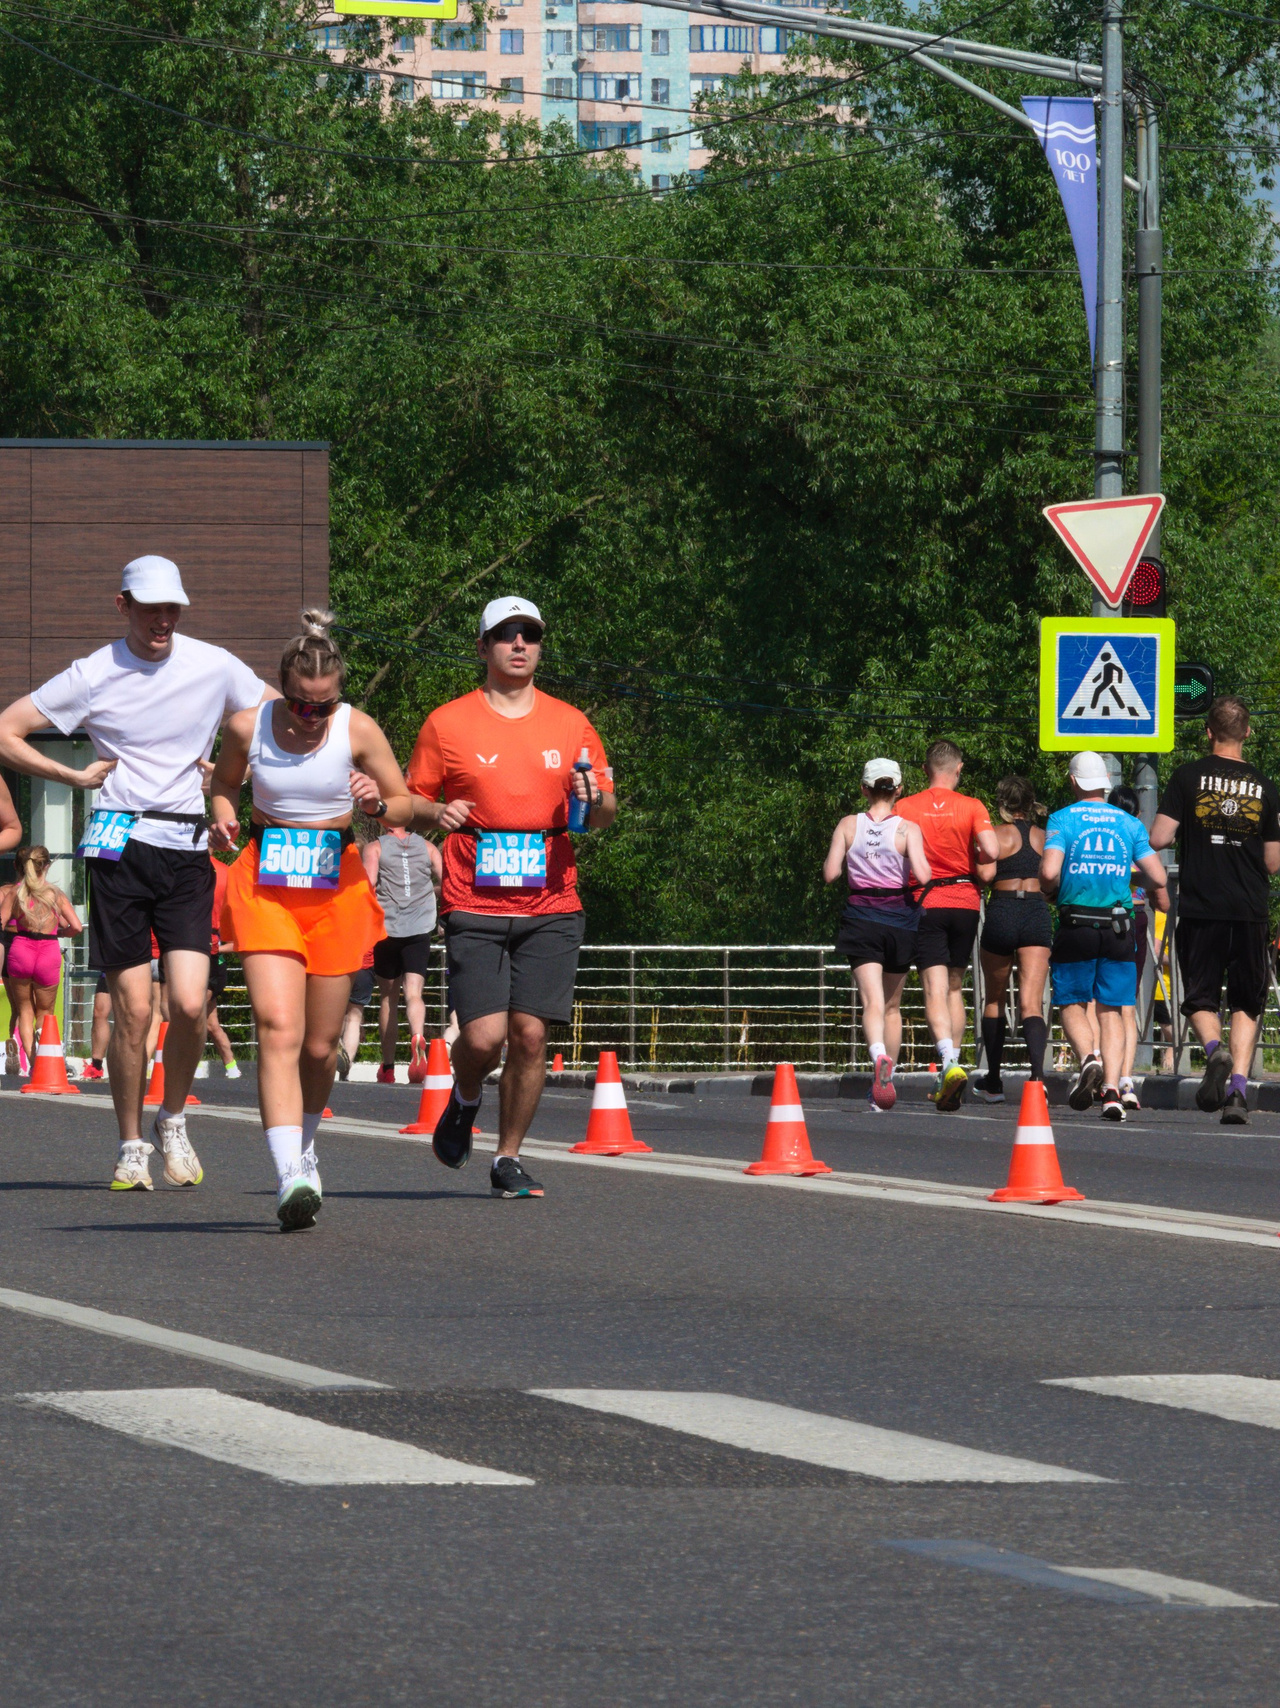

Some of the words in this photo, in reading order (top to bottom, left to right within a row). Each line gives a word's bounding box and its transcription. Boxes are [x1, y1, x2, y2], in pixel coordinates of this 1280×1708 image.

[1053, 148, 1091, 172] 100
[1062, 168, 1085, 184] ЛЕТ
[541, 749, 561, 769] 10
[1200, 775, 1263, 800] FINISHER
[1081, 813, 1117, 824] Серёга
[296, 831, 310, 844] 10
[505, 835, 519, 847] 10
[265, 843, 335, 875] 50019
[481, 848, 541, 874] 50312
[402, 857, 411, 897] OUTDOOR
[1068, 862, 1127, 877] САТУРН
[286, 874, 313, 888] 10KM
[499, 875, 523, 887] 10KM
